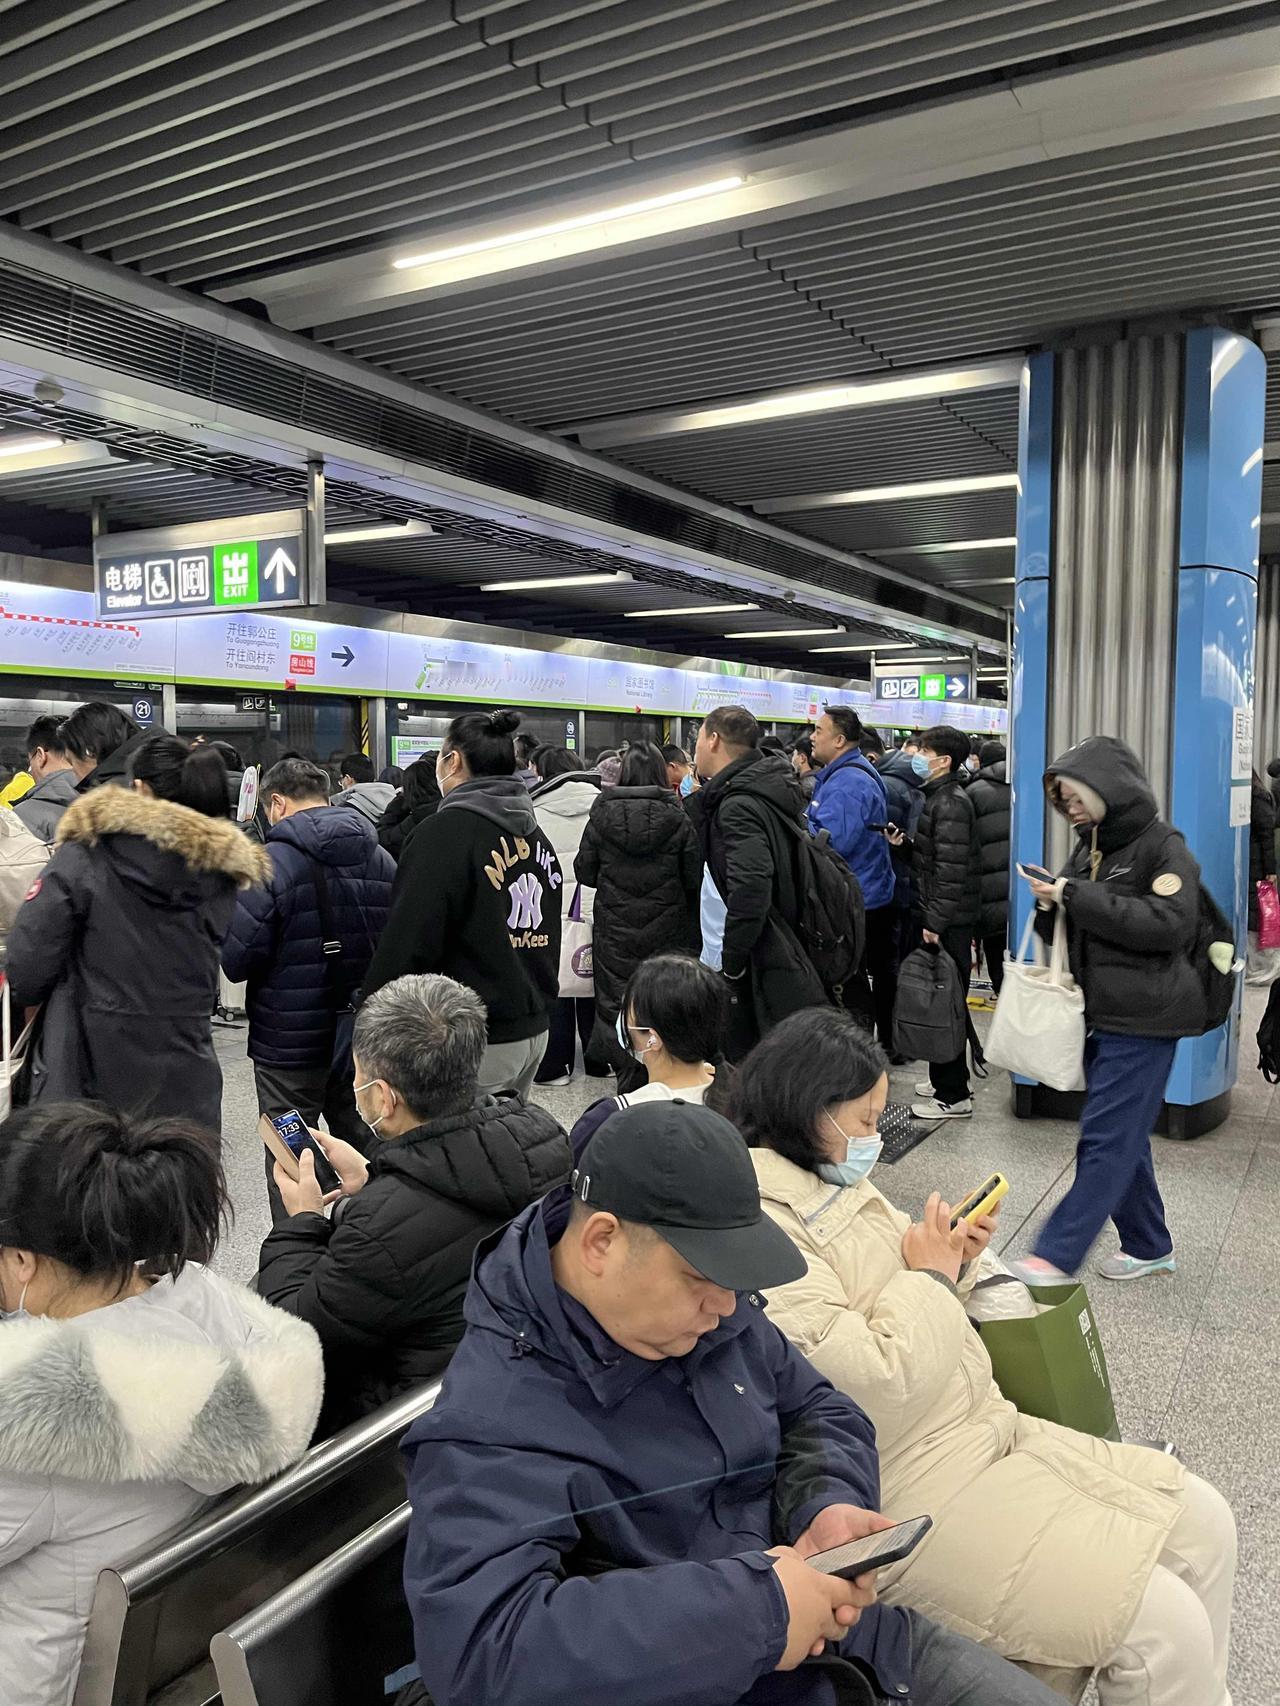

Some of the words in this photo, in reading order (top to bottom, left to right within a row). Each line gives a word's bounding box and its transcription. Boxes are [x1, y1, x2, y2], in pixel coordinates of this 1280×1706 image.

[223, 552, 248, 585] 出
[105, 563, 143, 591] 电梯
[223, 585, 248, 598] EXIT
[106, 594, 143, 608] Elevator
[226, 622, 277, 640] 开往郭公庄
[226, 648, 276, 664] 开往阎村东
[137, 704, 149, 715] 21
[484, 835, 531, 891] MLB
[277, 1122, 300, 1137] 17:33
